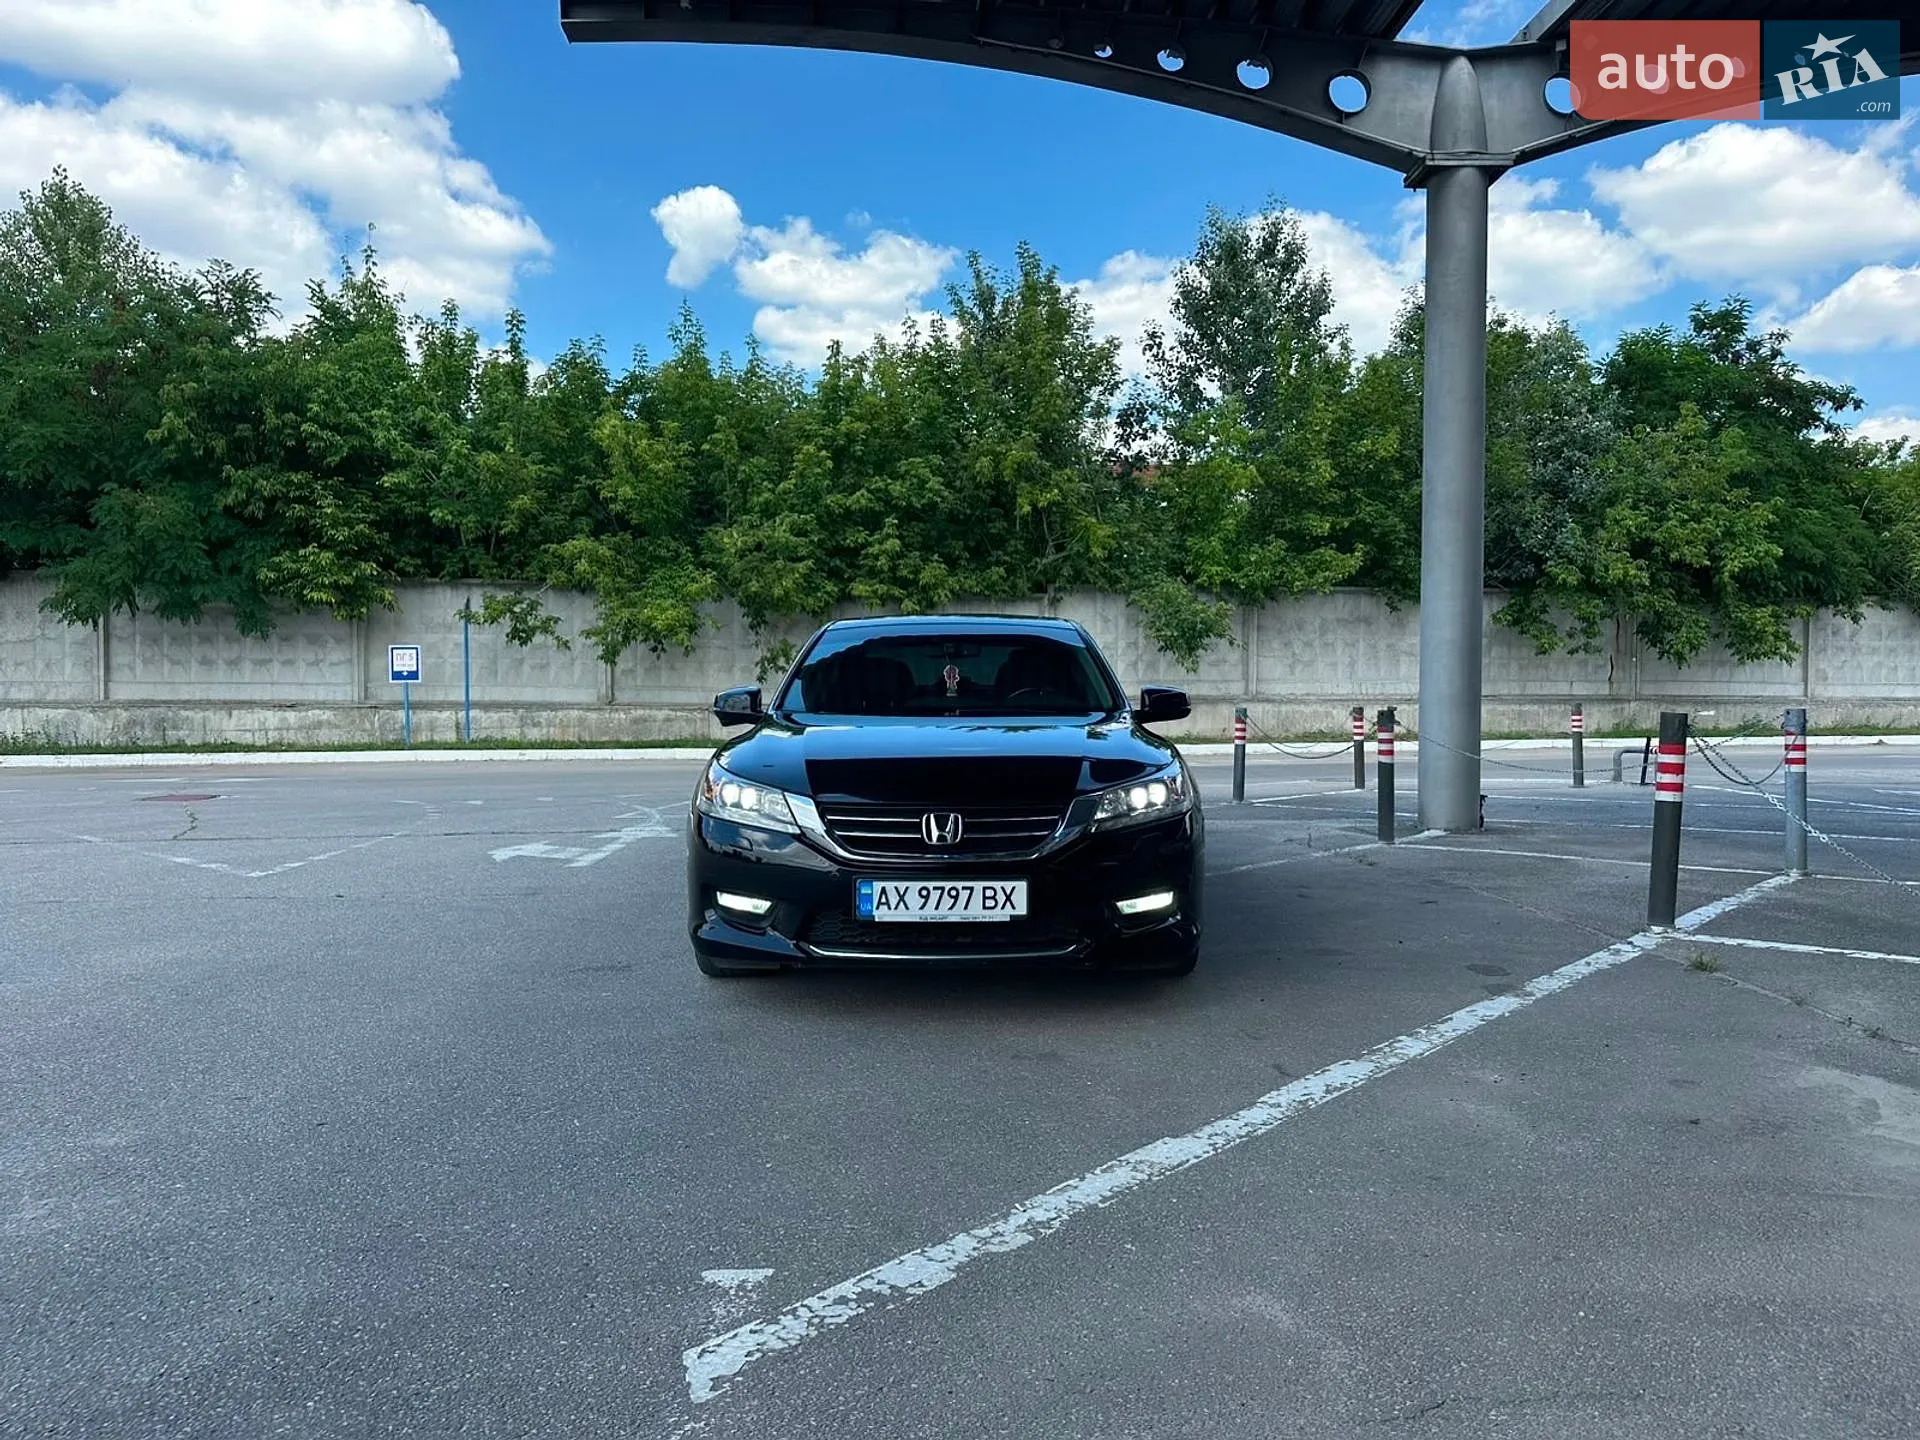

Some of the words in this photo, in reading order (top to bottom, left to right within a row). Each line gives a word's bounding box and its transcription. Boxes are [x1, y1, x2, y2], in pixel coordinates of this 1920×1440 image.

[875, 886, 910, 911] AX
[917, 886, 975, 911] 9797
[982, 886, 1017, 911] BX
[860, 903, 872, 911] UA
